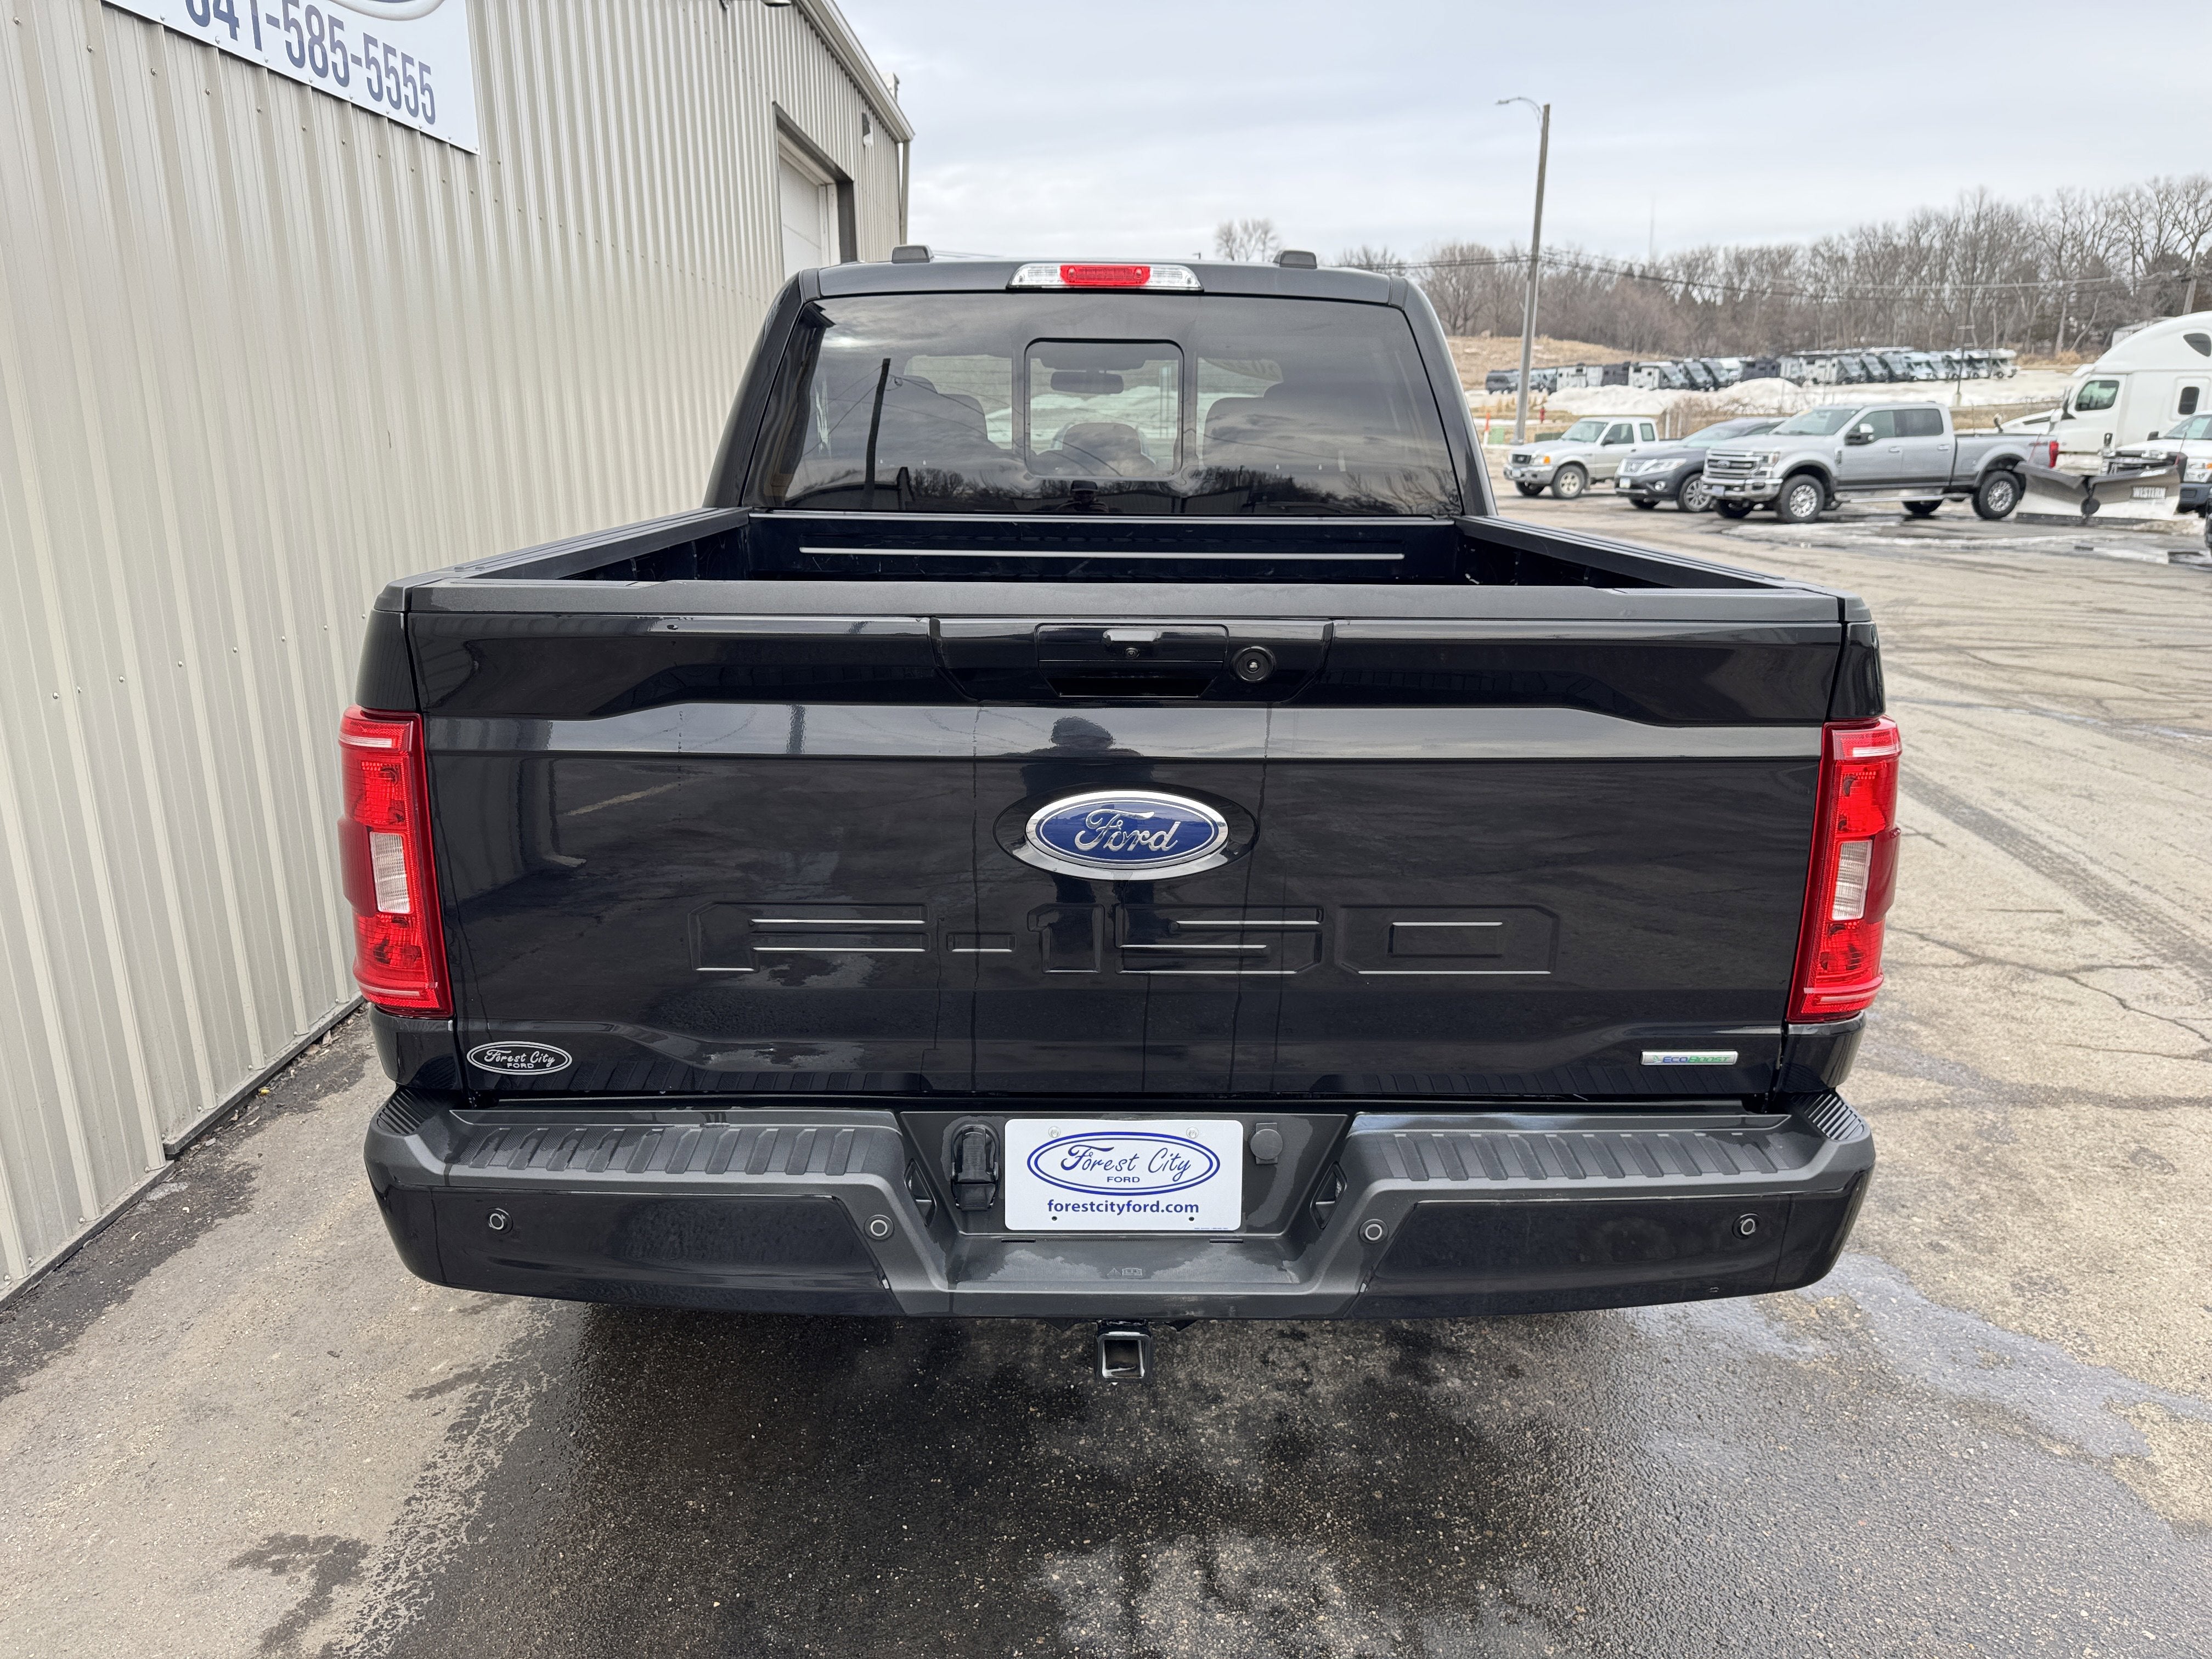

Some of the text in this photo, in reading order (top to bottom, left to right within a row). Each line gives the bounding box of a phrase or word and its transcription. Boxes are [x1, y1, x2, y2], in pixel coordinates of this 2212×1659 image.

[2132, 486, 2166, 499] WESTERN
[1074, 809, 1181, 852] Ford
[687, 901, 1560, 975] F-150
[484, 1049, 555, 1067] Forest City
[1060, 1144, 1191, 1182] Forest City
[1047, 1199, 1199, 1216] forestcityford.com
